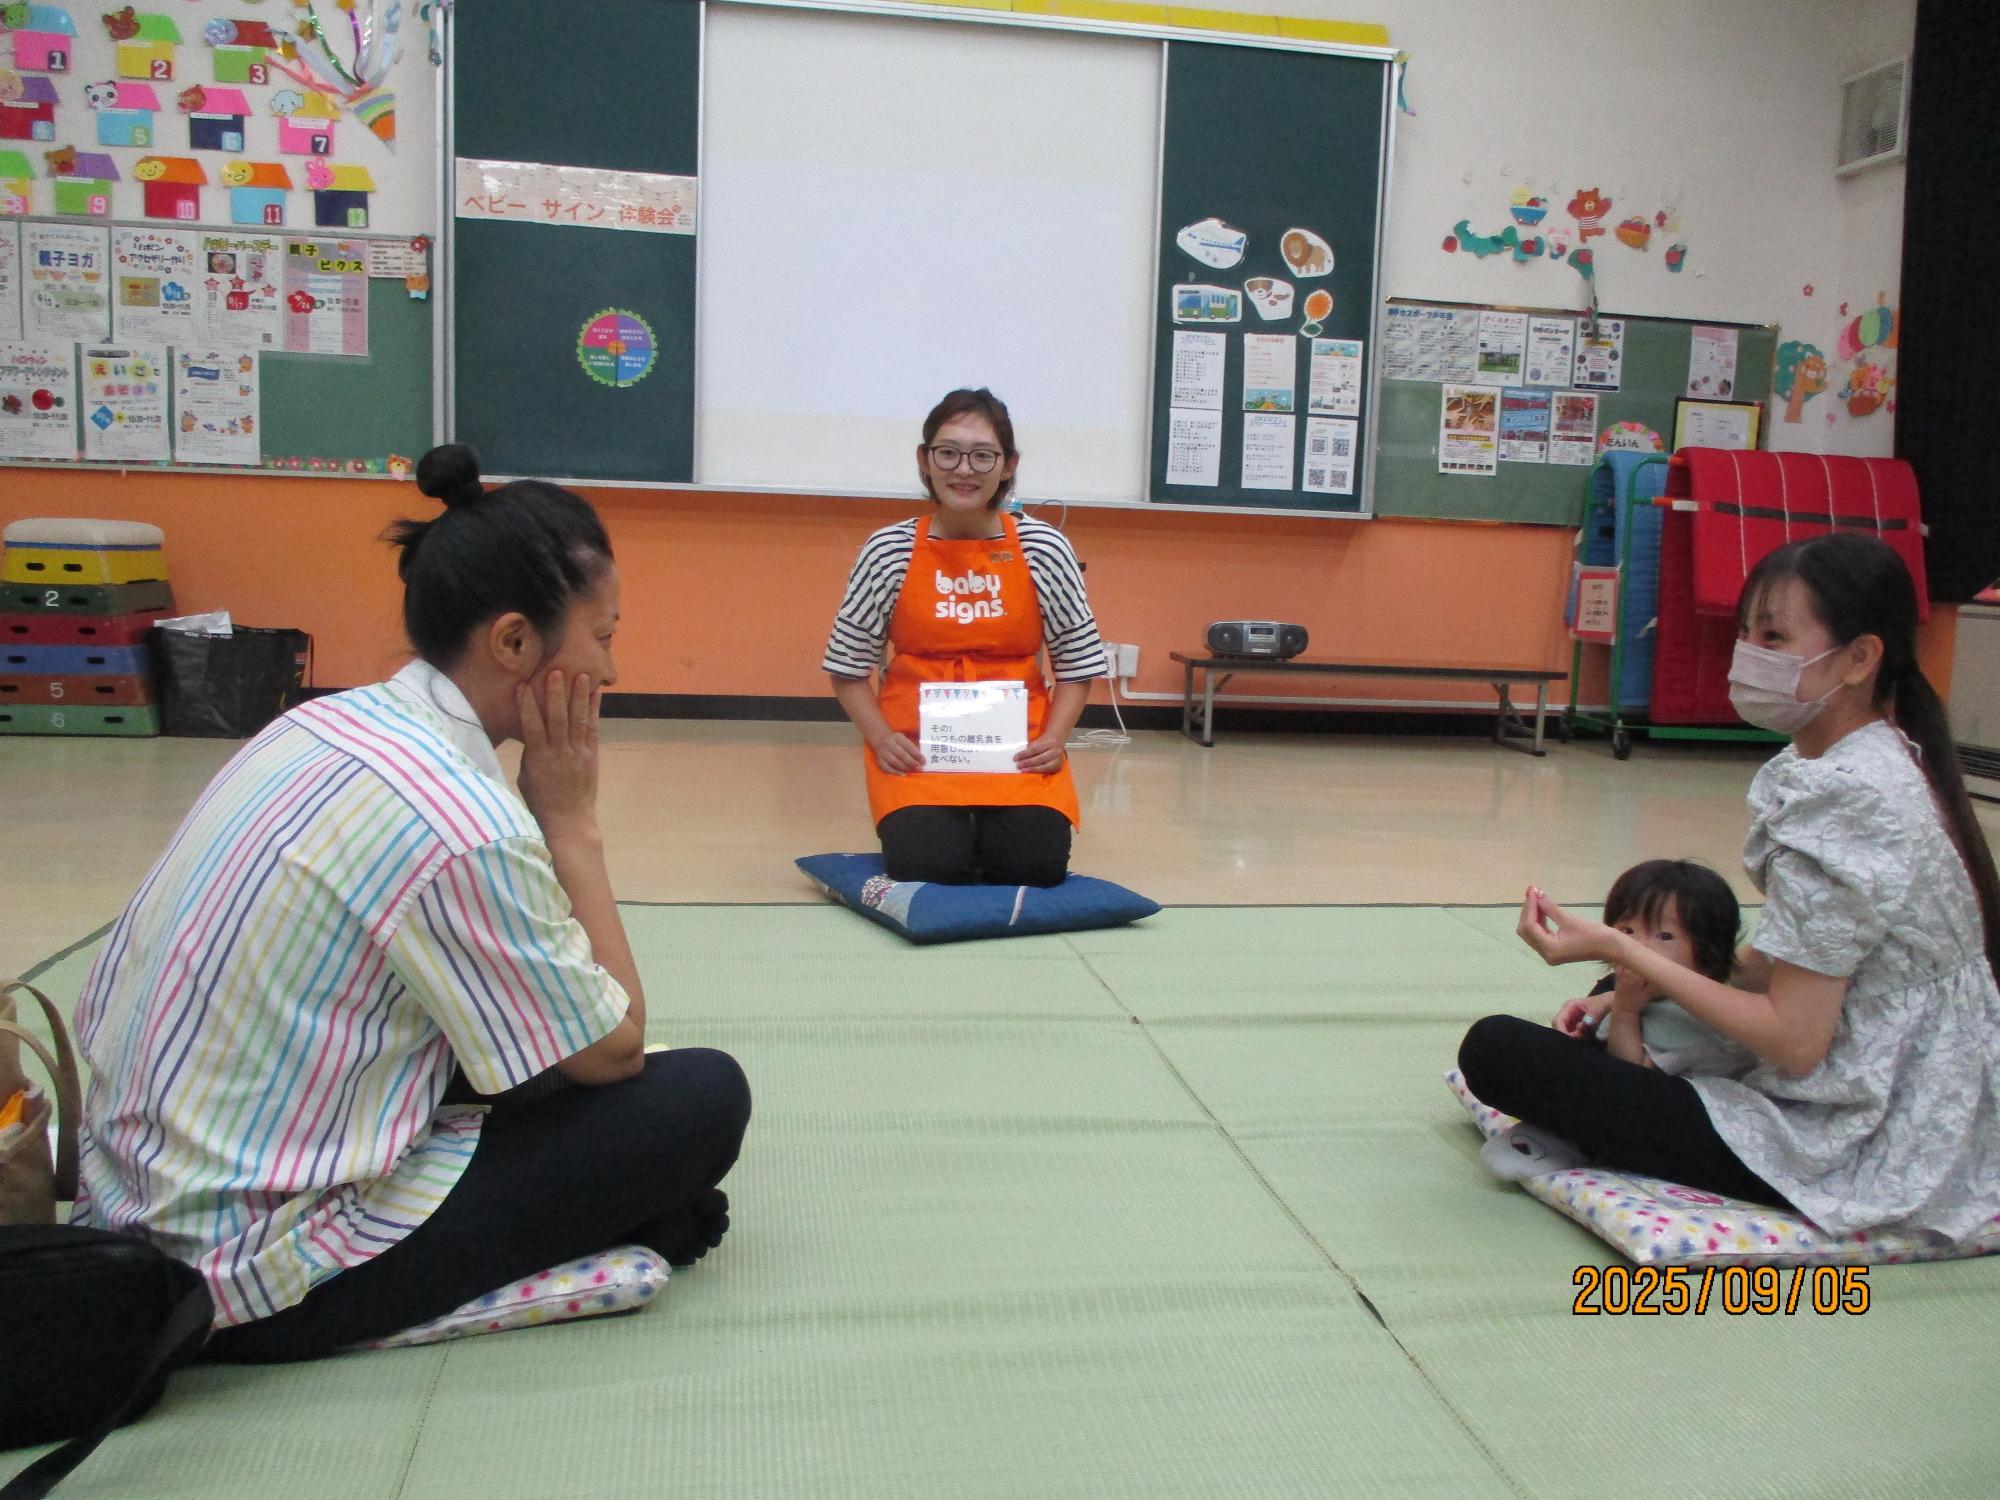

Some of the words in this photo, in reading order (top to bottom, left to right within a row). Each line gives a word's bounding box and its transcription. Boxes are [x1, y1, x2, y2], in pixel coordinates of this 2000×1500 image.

[50, 51, 64, 69] 1
[154, 61, 168, 79] 2
[252, 65, 266, 83] 3
[315, 136, 327, 153] 7
[92, 196, 105, 212] 9
[179, 201, 194, 218] 10
[265, 206, 281, 224] 11
[542, 200, 604, 220] サイン
[619, 204, 674, 226] 体験会
[935, 569, 1001, 598] baby
[45, 590, 60, 607] 2
[935, 595, 1003, 624] signs
[50, 682, 64, 698] 5
[52, 713, 65, 728] 6
[931, 734, 1002, 744] いつもの離乳食を
[930, 754, 971, 764] 食べない。
